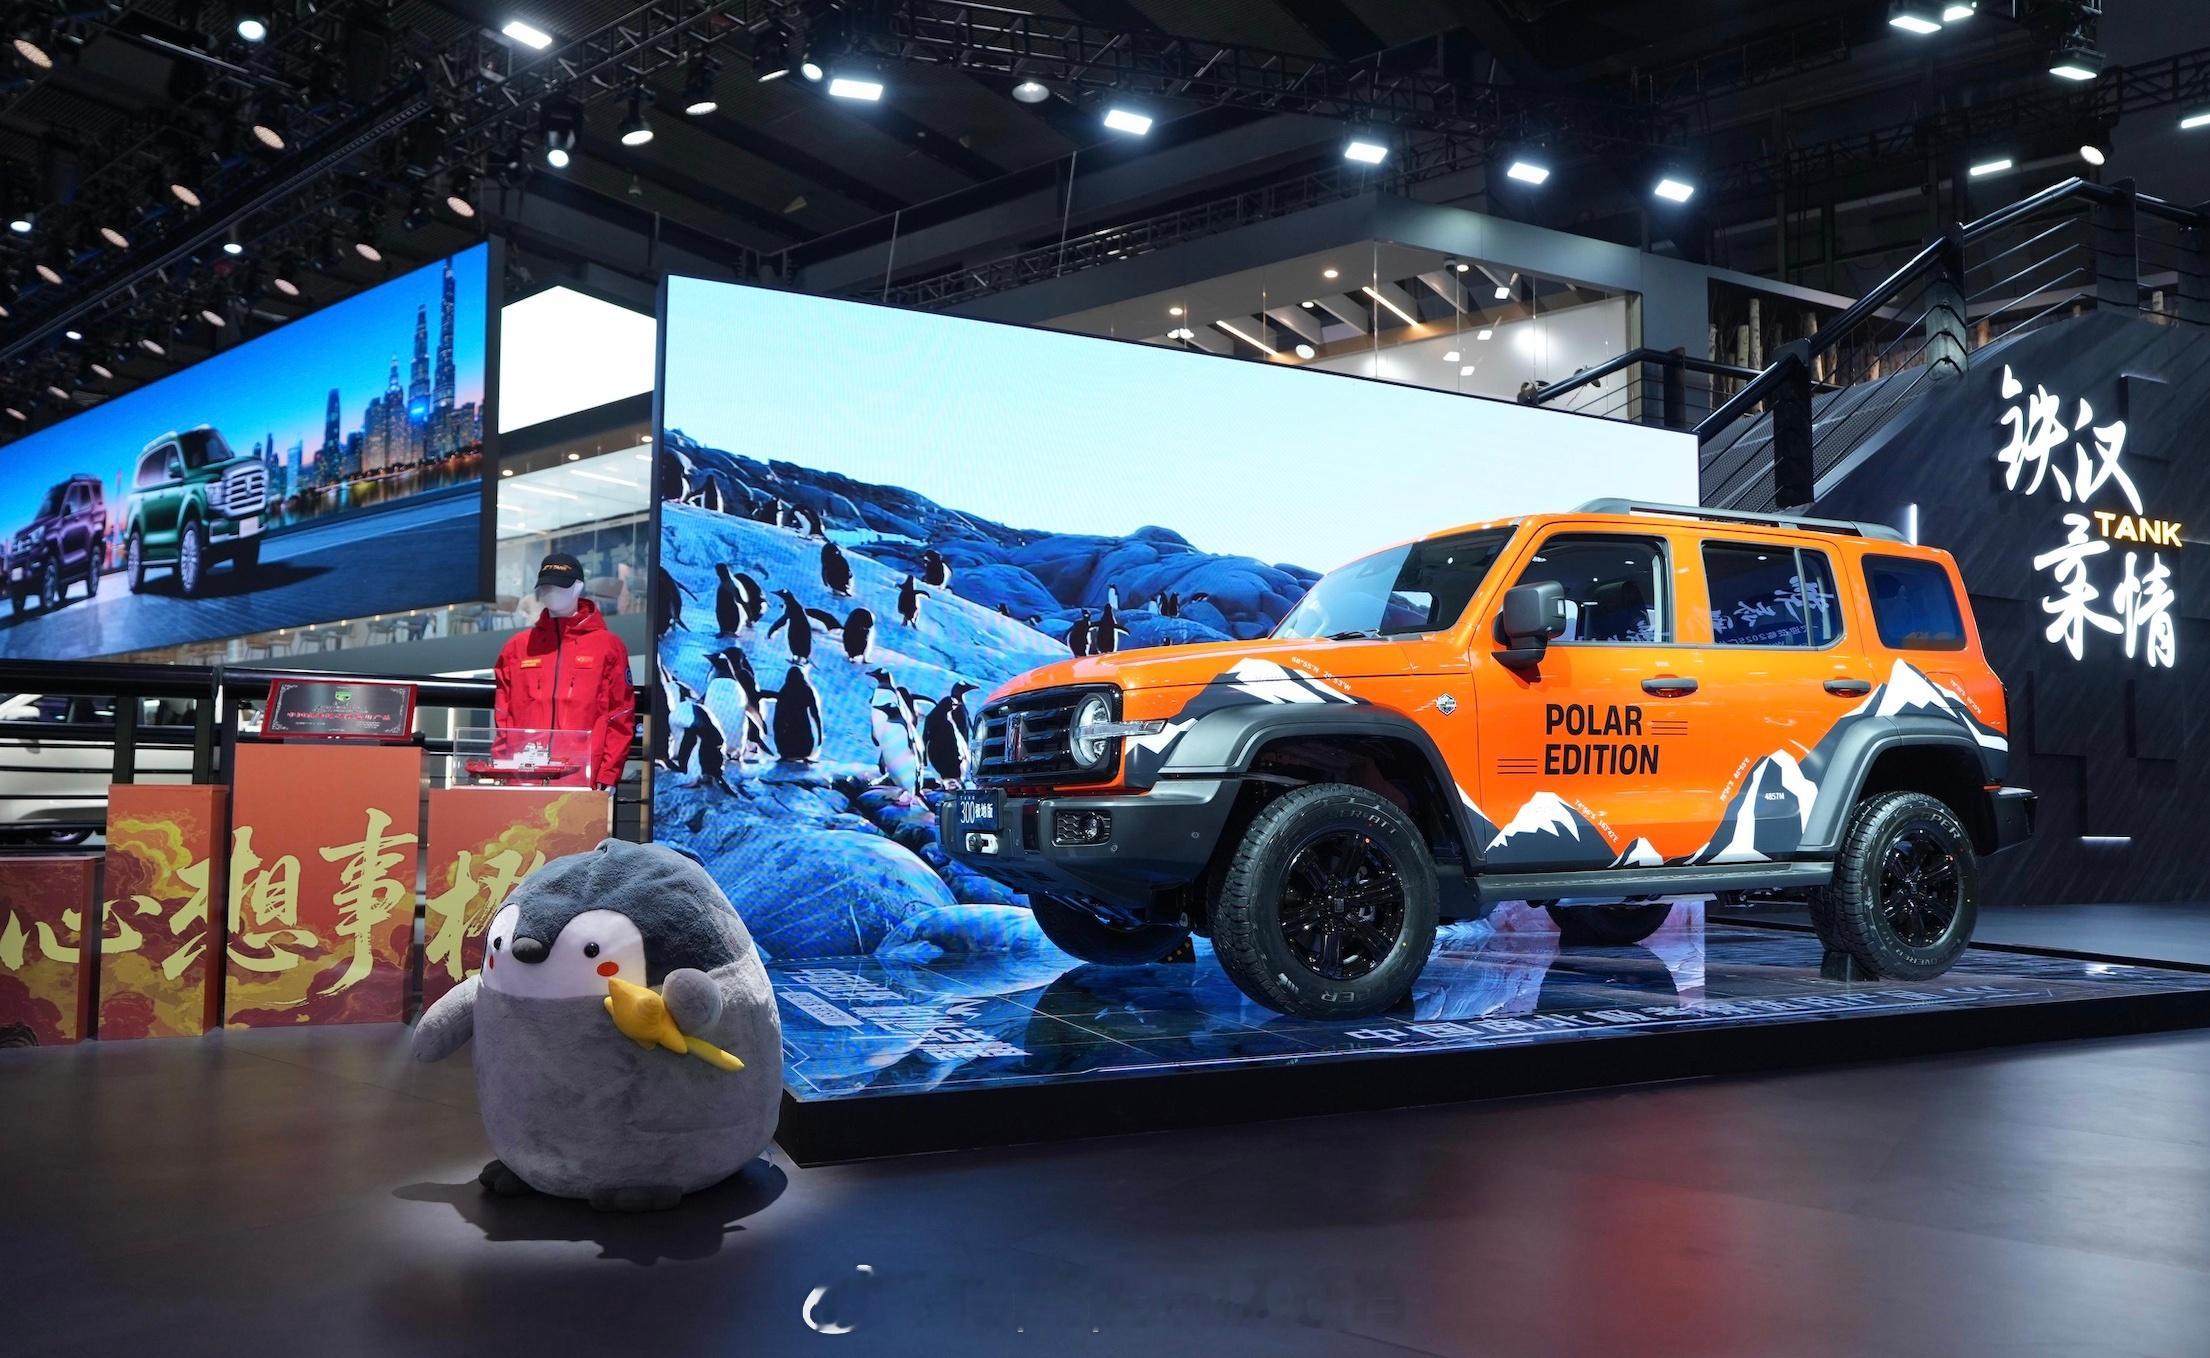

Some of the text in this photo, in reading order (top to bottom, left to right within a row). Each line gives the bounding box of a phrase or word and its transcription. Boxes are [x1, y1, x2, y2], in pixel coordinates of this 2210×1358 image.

[1997, 364, 2144, 515] 铁汉
[2093, 510, 2183, 548] TANK
[2033, 513, 2176, 668] 柔情
[1545, 703, 1643, 737] POLAR
[1544, 743, 1659, 775] EDITION
